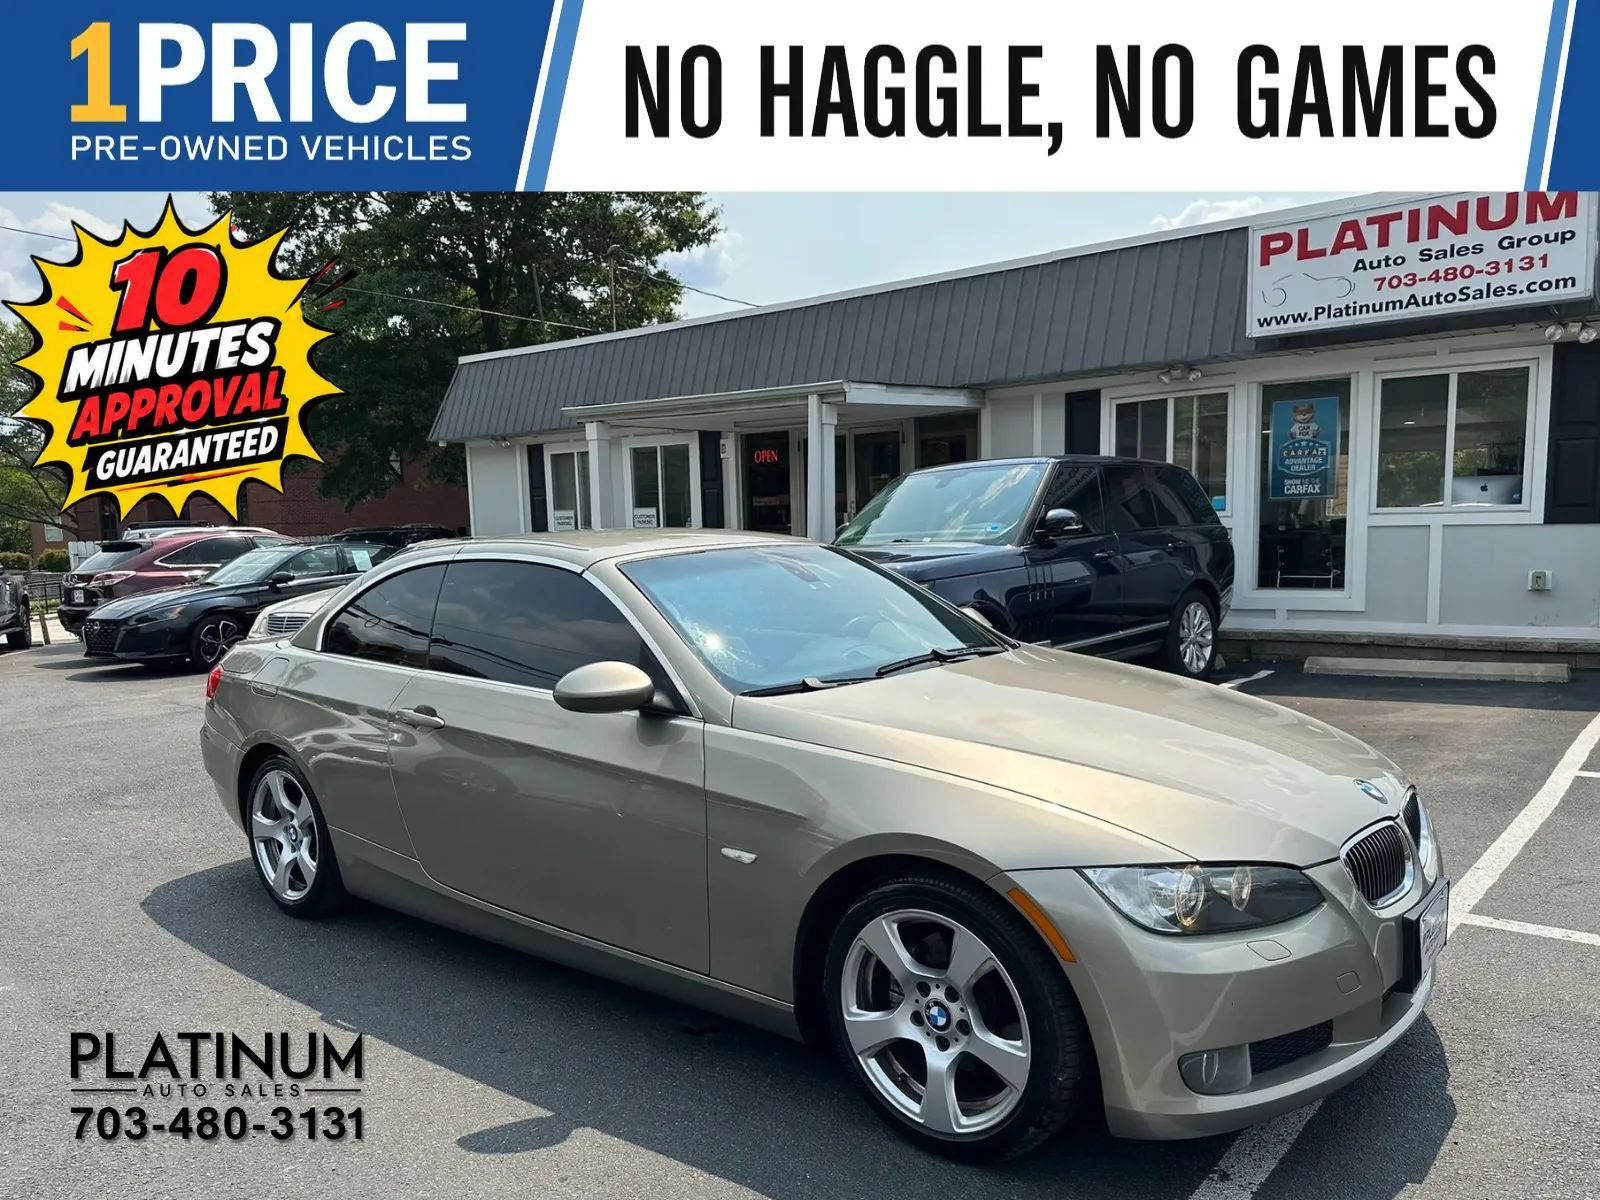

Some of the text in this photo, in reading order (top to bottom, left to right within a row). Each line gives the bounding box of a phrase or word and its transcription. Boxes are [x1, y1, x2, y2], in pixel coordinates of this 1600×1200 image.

[1260, 192, 1578, 267] PLATINUM
[1353, 228, 1576, 273] Auto Sales Group
[1373, 254, 1549, 292] 703-480-3131
[1257, 275, 1577, 328] www.PlatinumAutoSales.com
[754, 449, 778, 464] OPEN
[1283, 448, 1326, 456] CARFAX
[1285, 457, 1322, 465] ADVANTAGE
[1284, 484, 1320, 494] CARFAX
